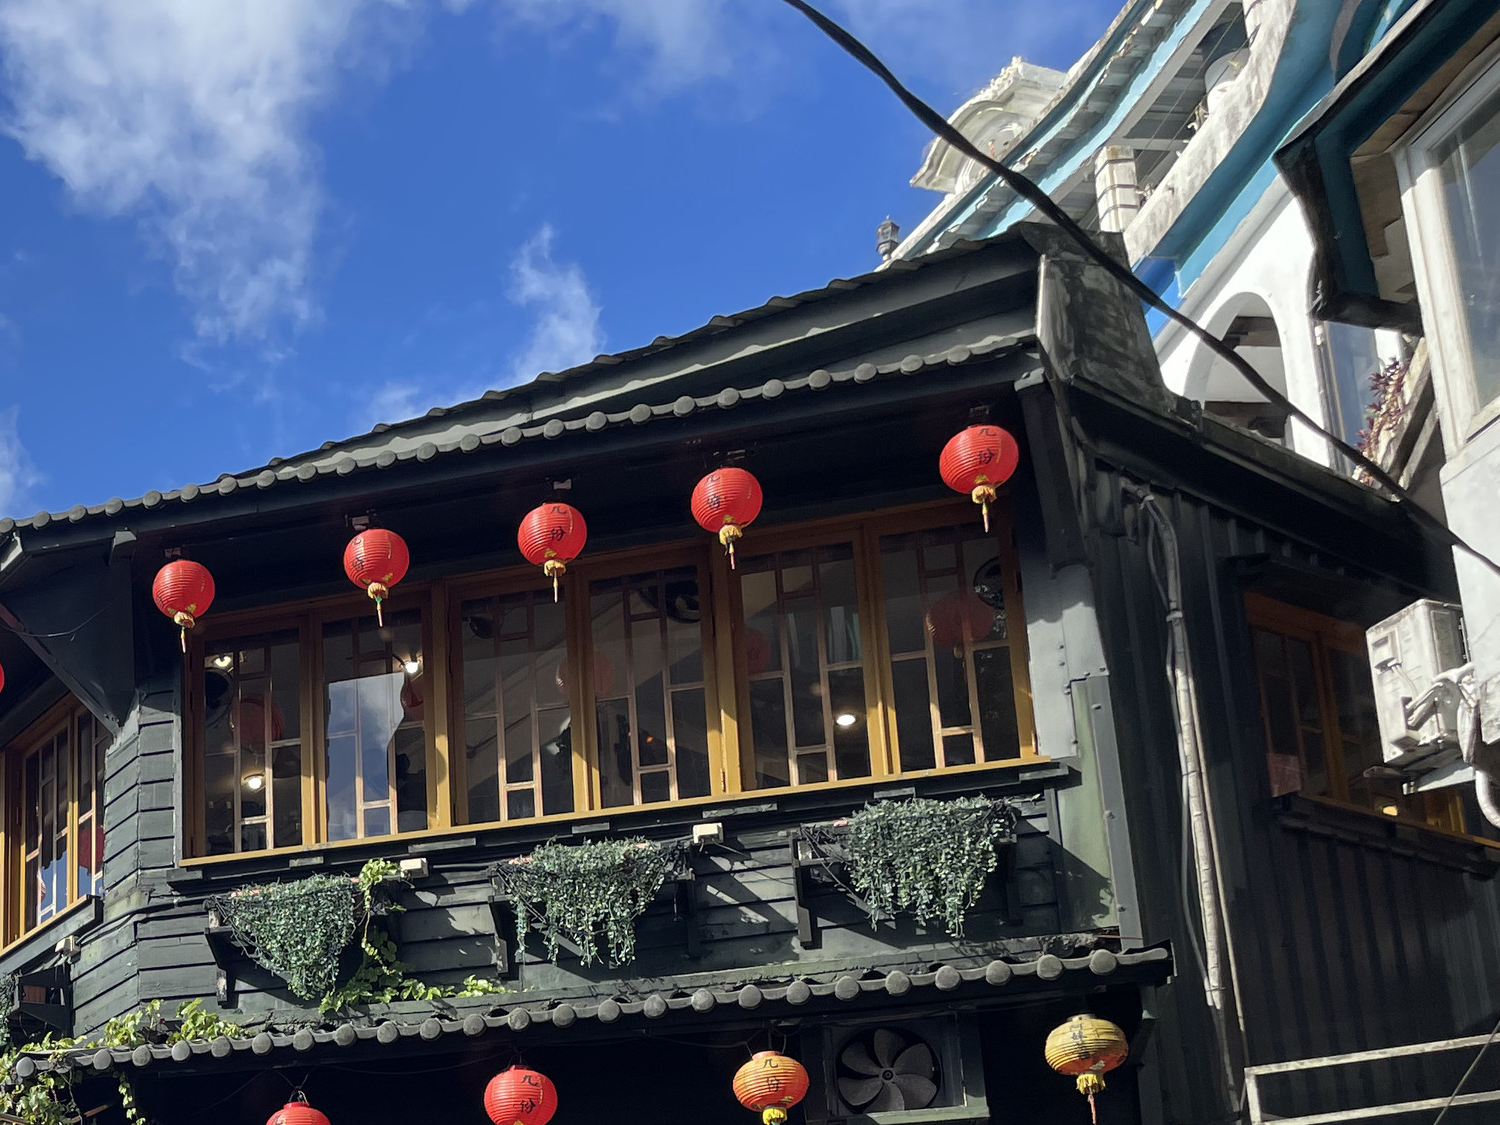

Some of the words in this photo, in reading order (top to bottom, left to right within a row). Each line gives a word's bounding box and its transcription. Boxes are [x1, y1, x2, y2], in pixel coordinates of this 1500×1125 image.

[977, 427, 997, 464] 九份
[550, 506, 568, 542] 九份
[520, 1075, 539, 1114] 九份
